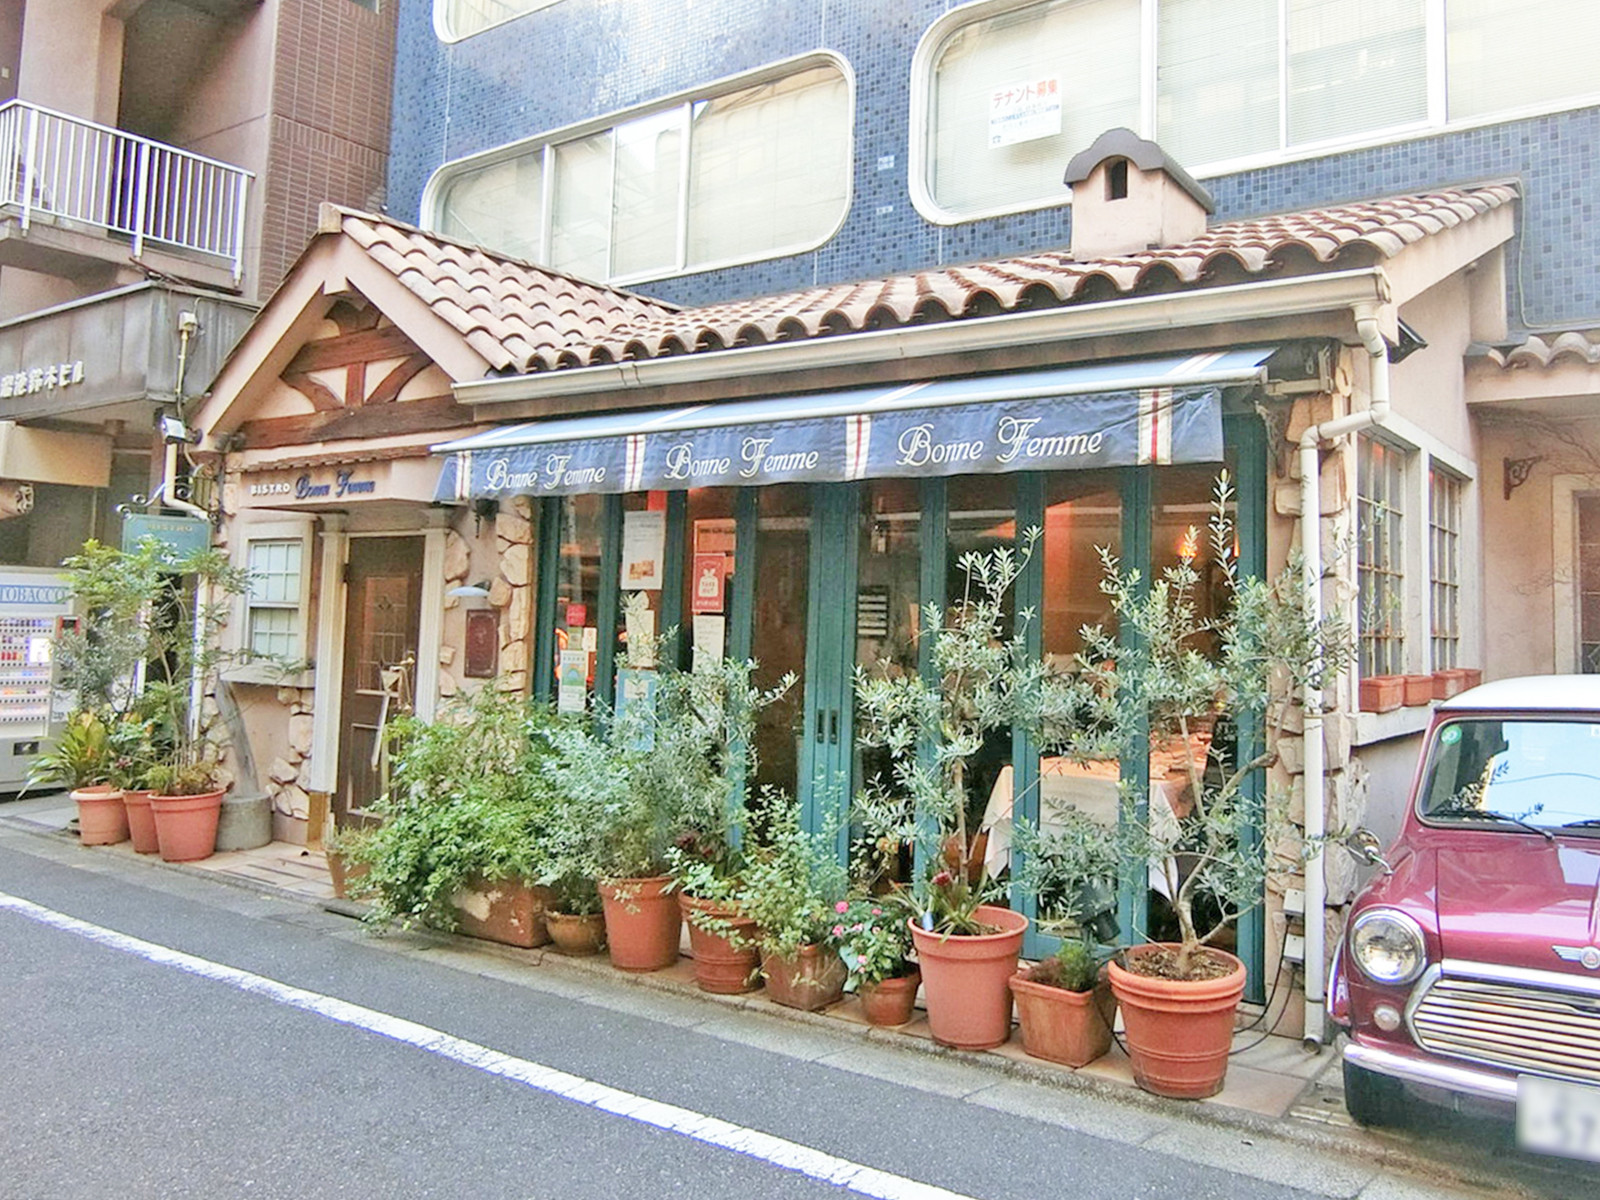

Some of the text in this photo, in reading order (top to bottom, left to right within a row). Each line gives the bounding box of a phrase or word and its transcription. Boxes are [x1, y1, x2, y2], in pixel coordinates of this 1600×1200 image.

[993, 80, 1058, 109] テナント募集
[663, 437, 819, 480] Bonne Femme
[895, 416, 1103, 466] Bonne Femme
[250, 483, 291, 496] BISTRO
[483, 454, 606, 491] Bonne Femme
